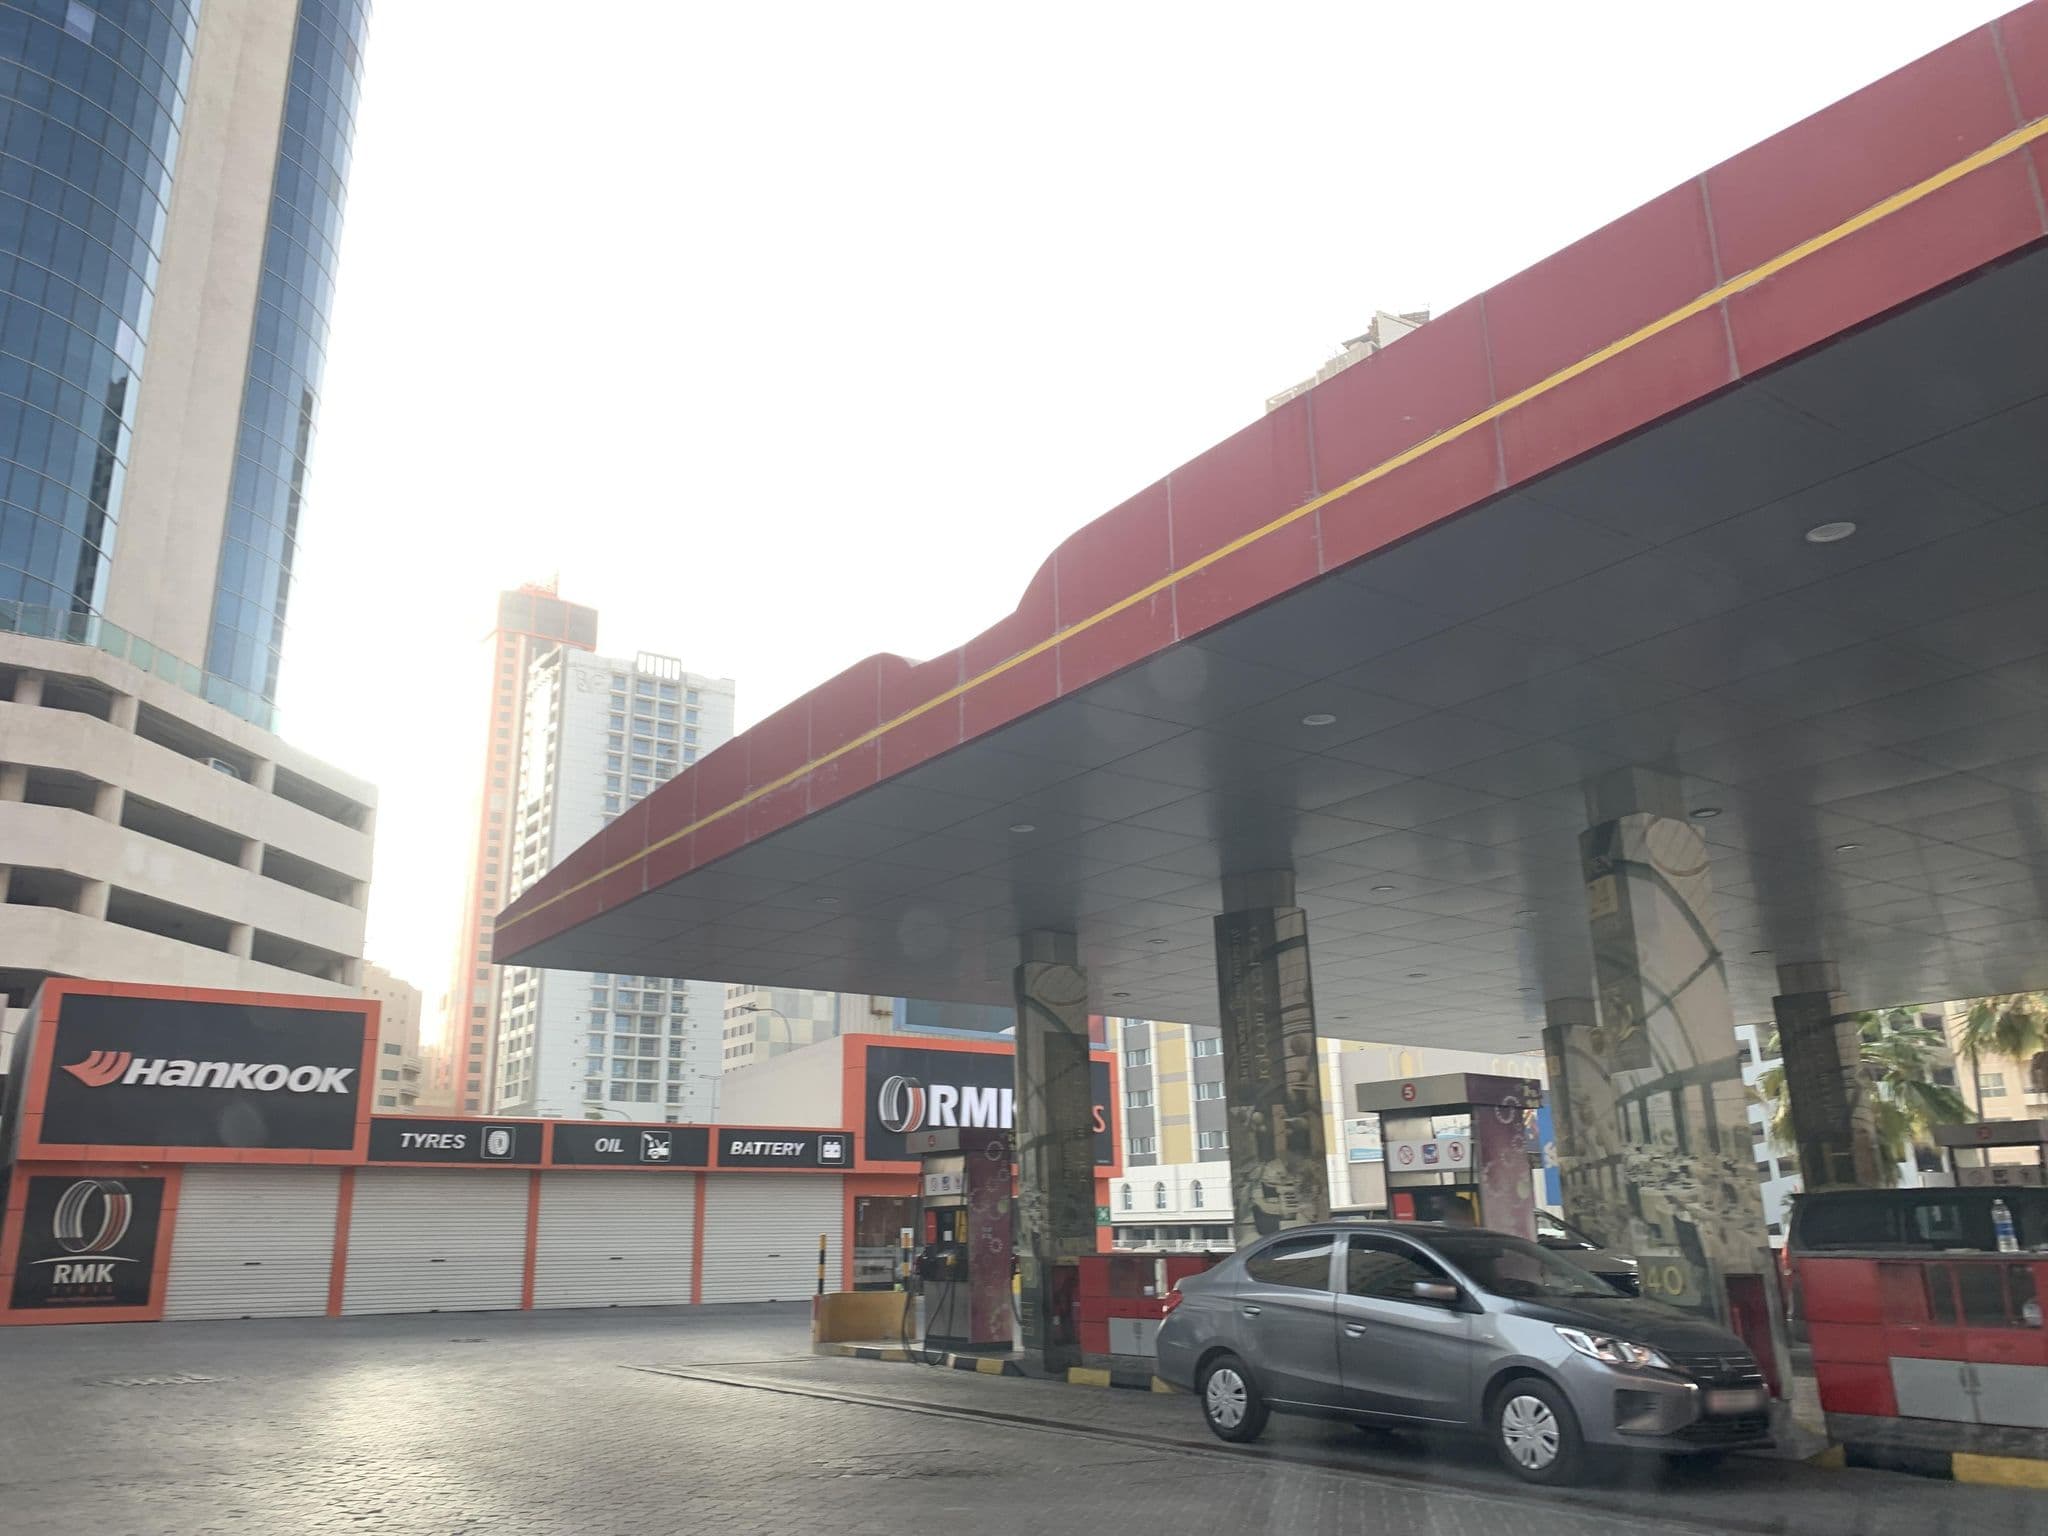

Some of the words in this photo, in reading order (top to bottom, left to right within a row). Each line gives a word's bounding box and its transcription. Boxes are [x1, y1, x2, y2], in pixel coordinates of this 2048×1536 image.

[399, 1132, 467, 1150] TYRES
[594, 1137, 625, 1154] OIL
[729, 1139, 806, 1158] BATTERY
[53, 1263, 115, 1284] RMK
